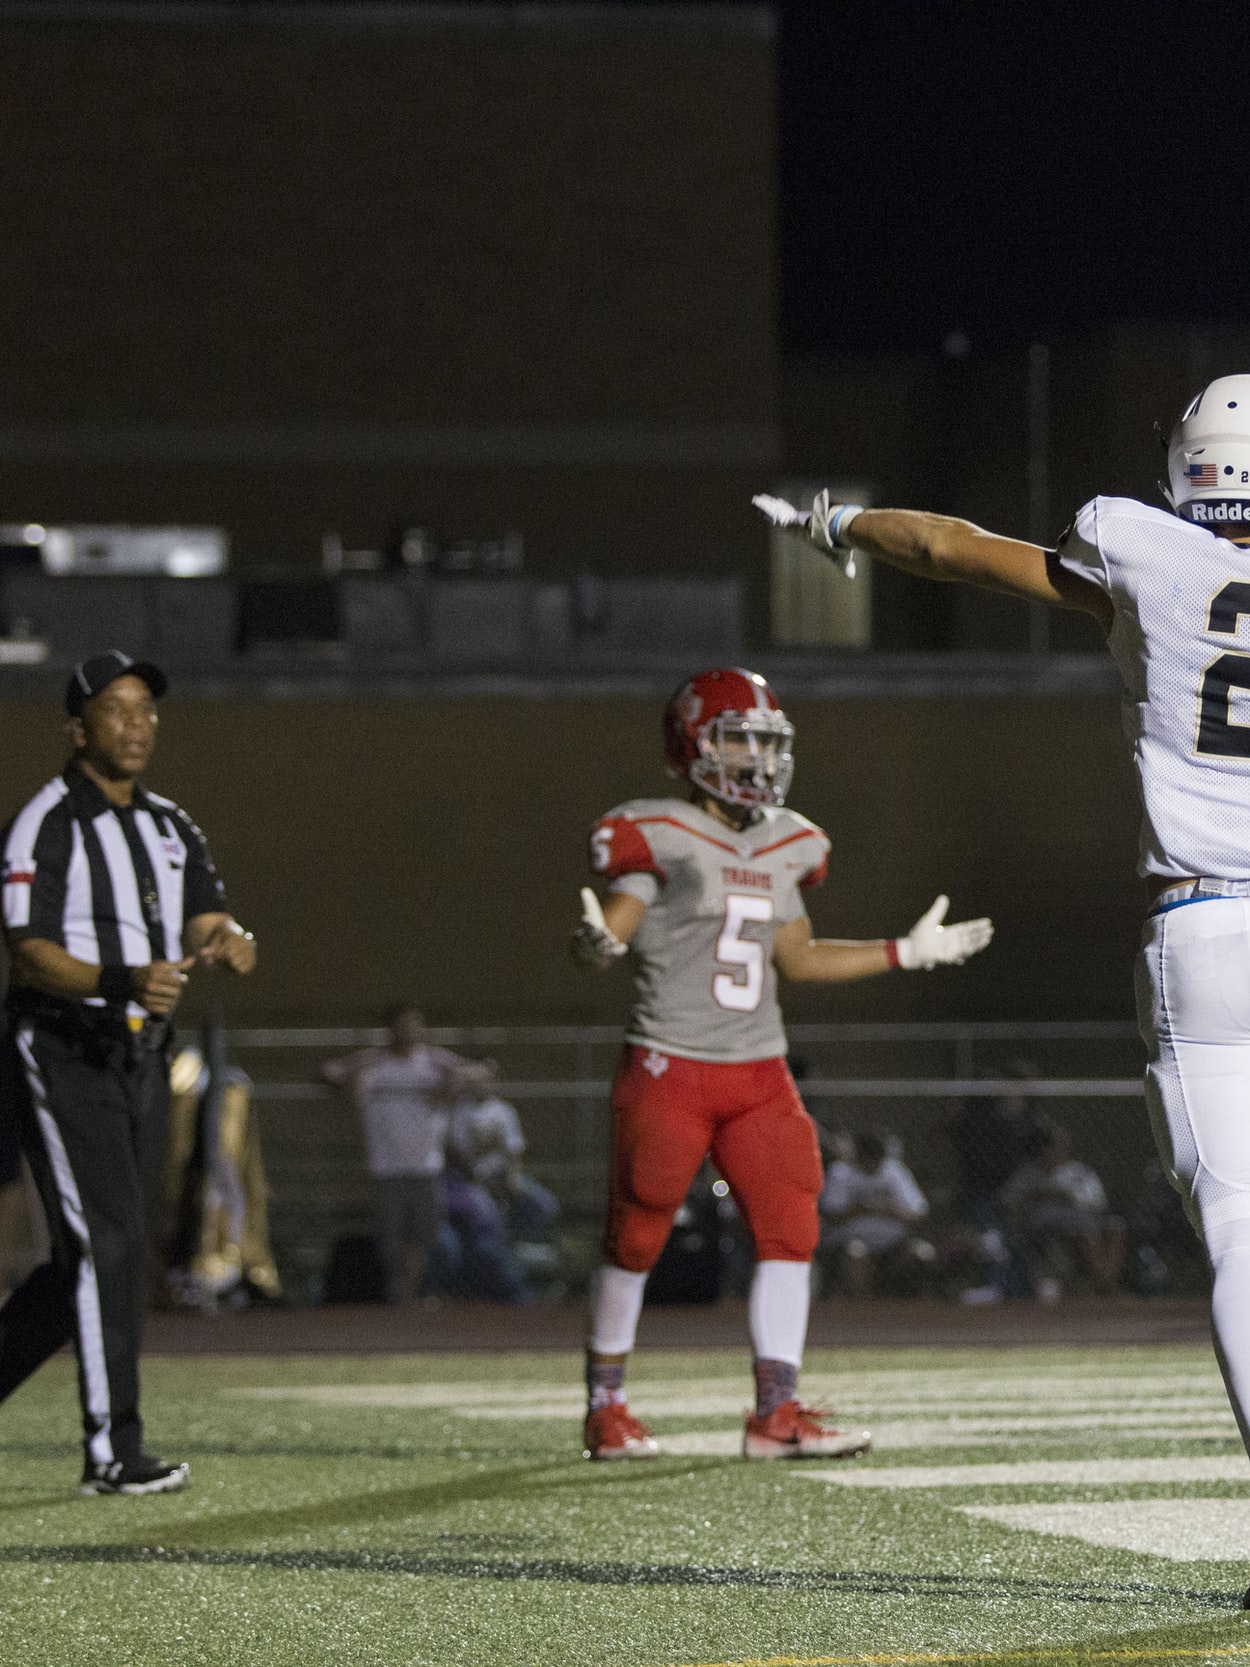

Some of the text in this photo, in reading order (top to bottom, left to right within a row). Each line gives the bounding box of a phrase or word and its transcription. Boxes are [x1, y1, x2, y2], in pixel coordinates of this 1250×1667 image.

[1241, 470, 1249, 483] 2
[591, 826, 614, 869] 5
[713, 893, 774, 1012] 5
